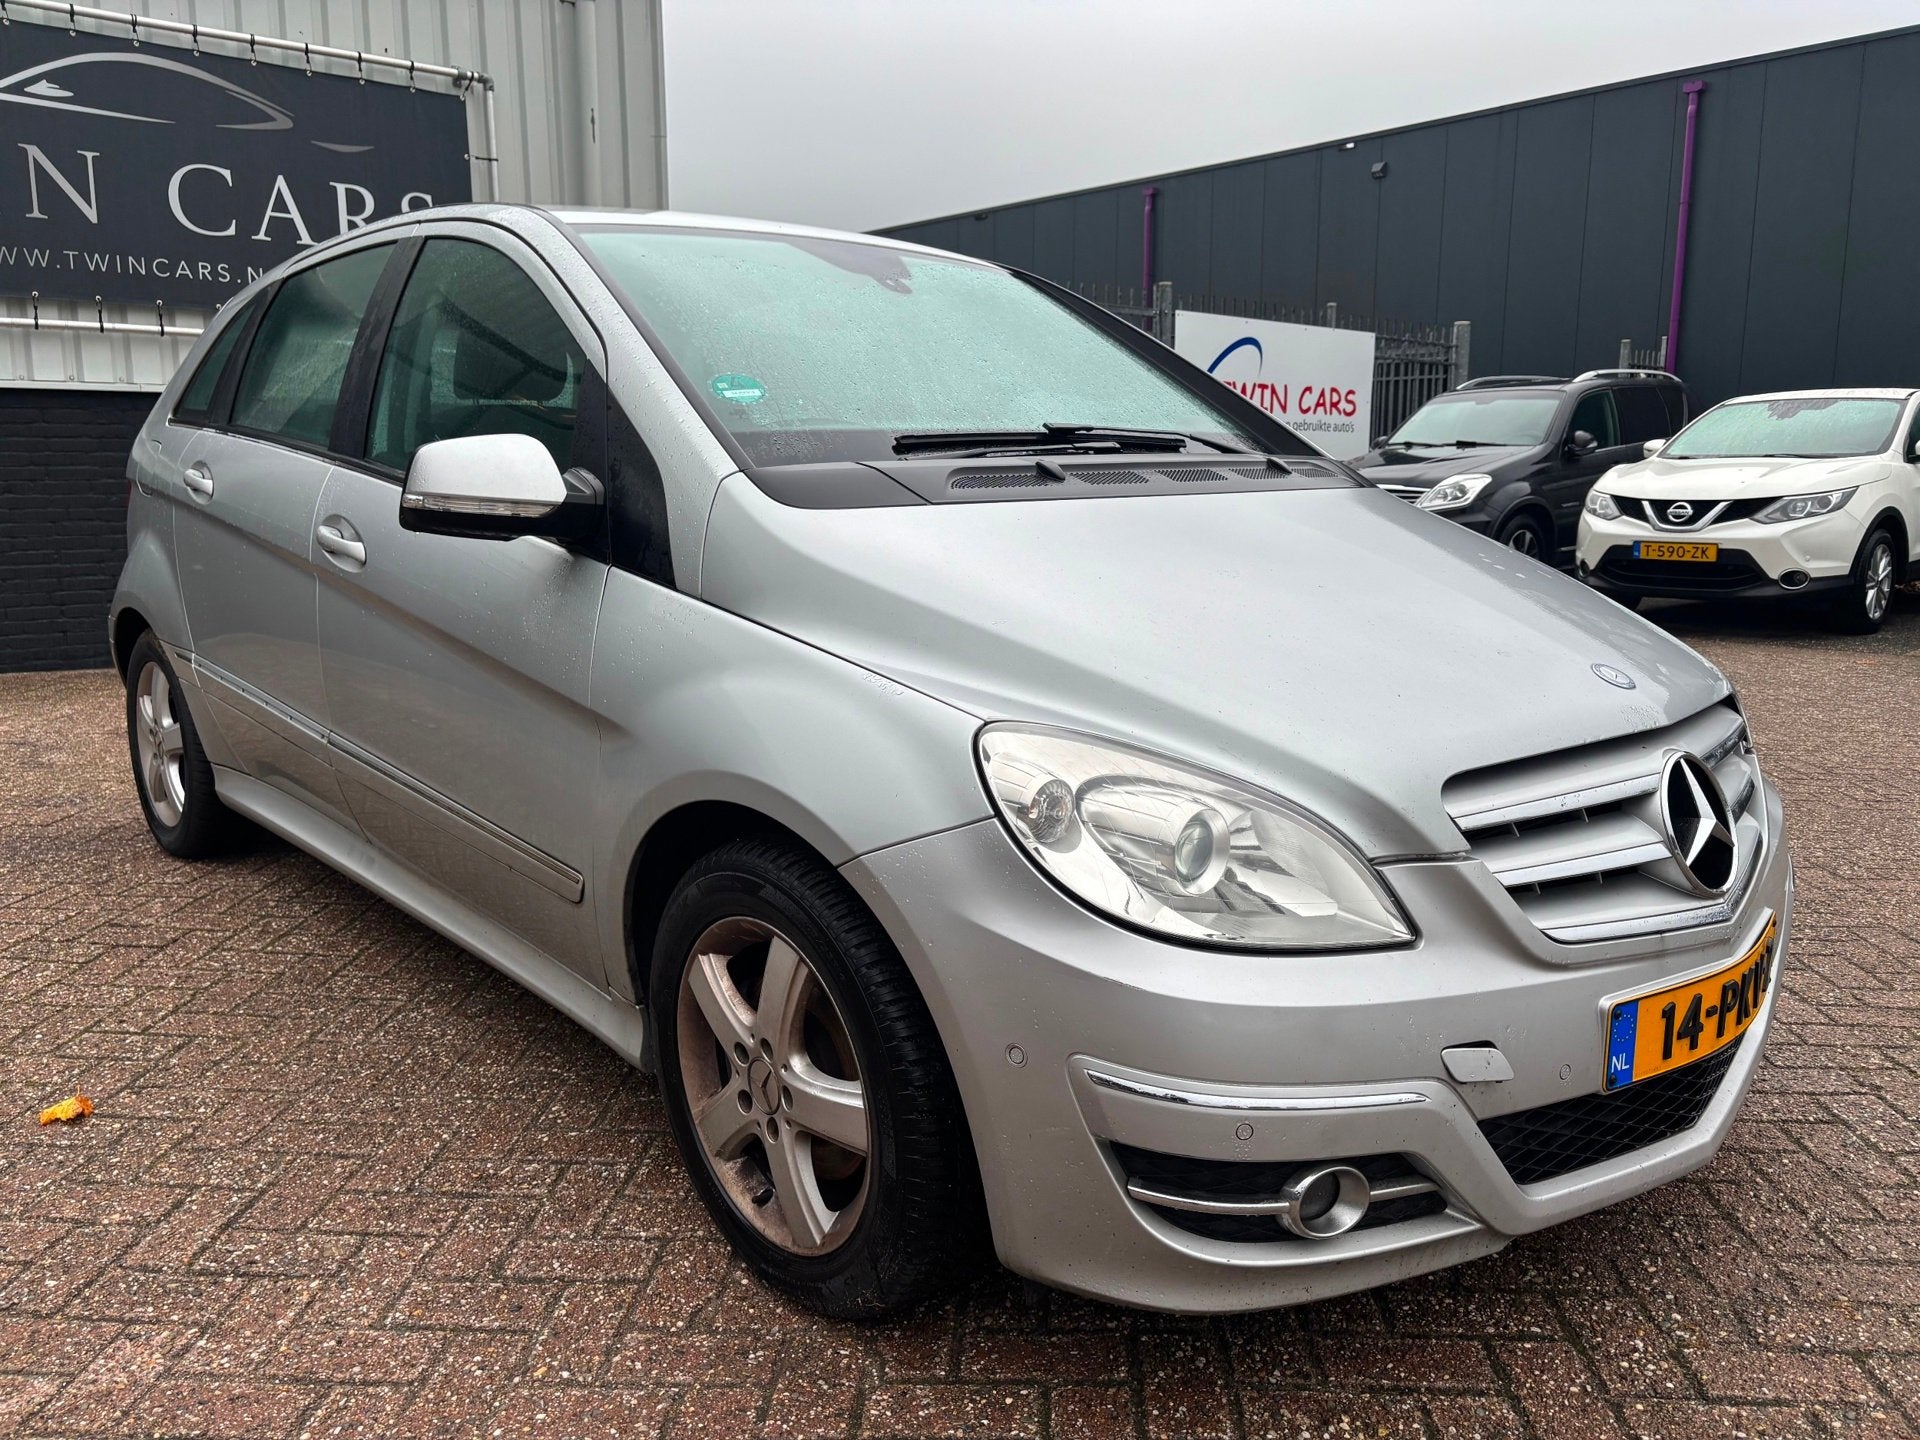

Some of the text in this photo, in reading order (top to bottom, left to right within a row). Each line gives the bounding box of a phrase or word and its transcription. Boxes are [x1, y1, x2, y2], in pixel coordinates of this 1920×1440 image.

[1223, 381, 1356, 417] WIN CARS
[1292, 419, 1331, 432] gebruikte
[1333, 421, 1355, 433] auto's
[1644, 544, 1710, 559] T-590-ZK
[1611, 1053, 1630, 1073] NL
